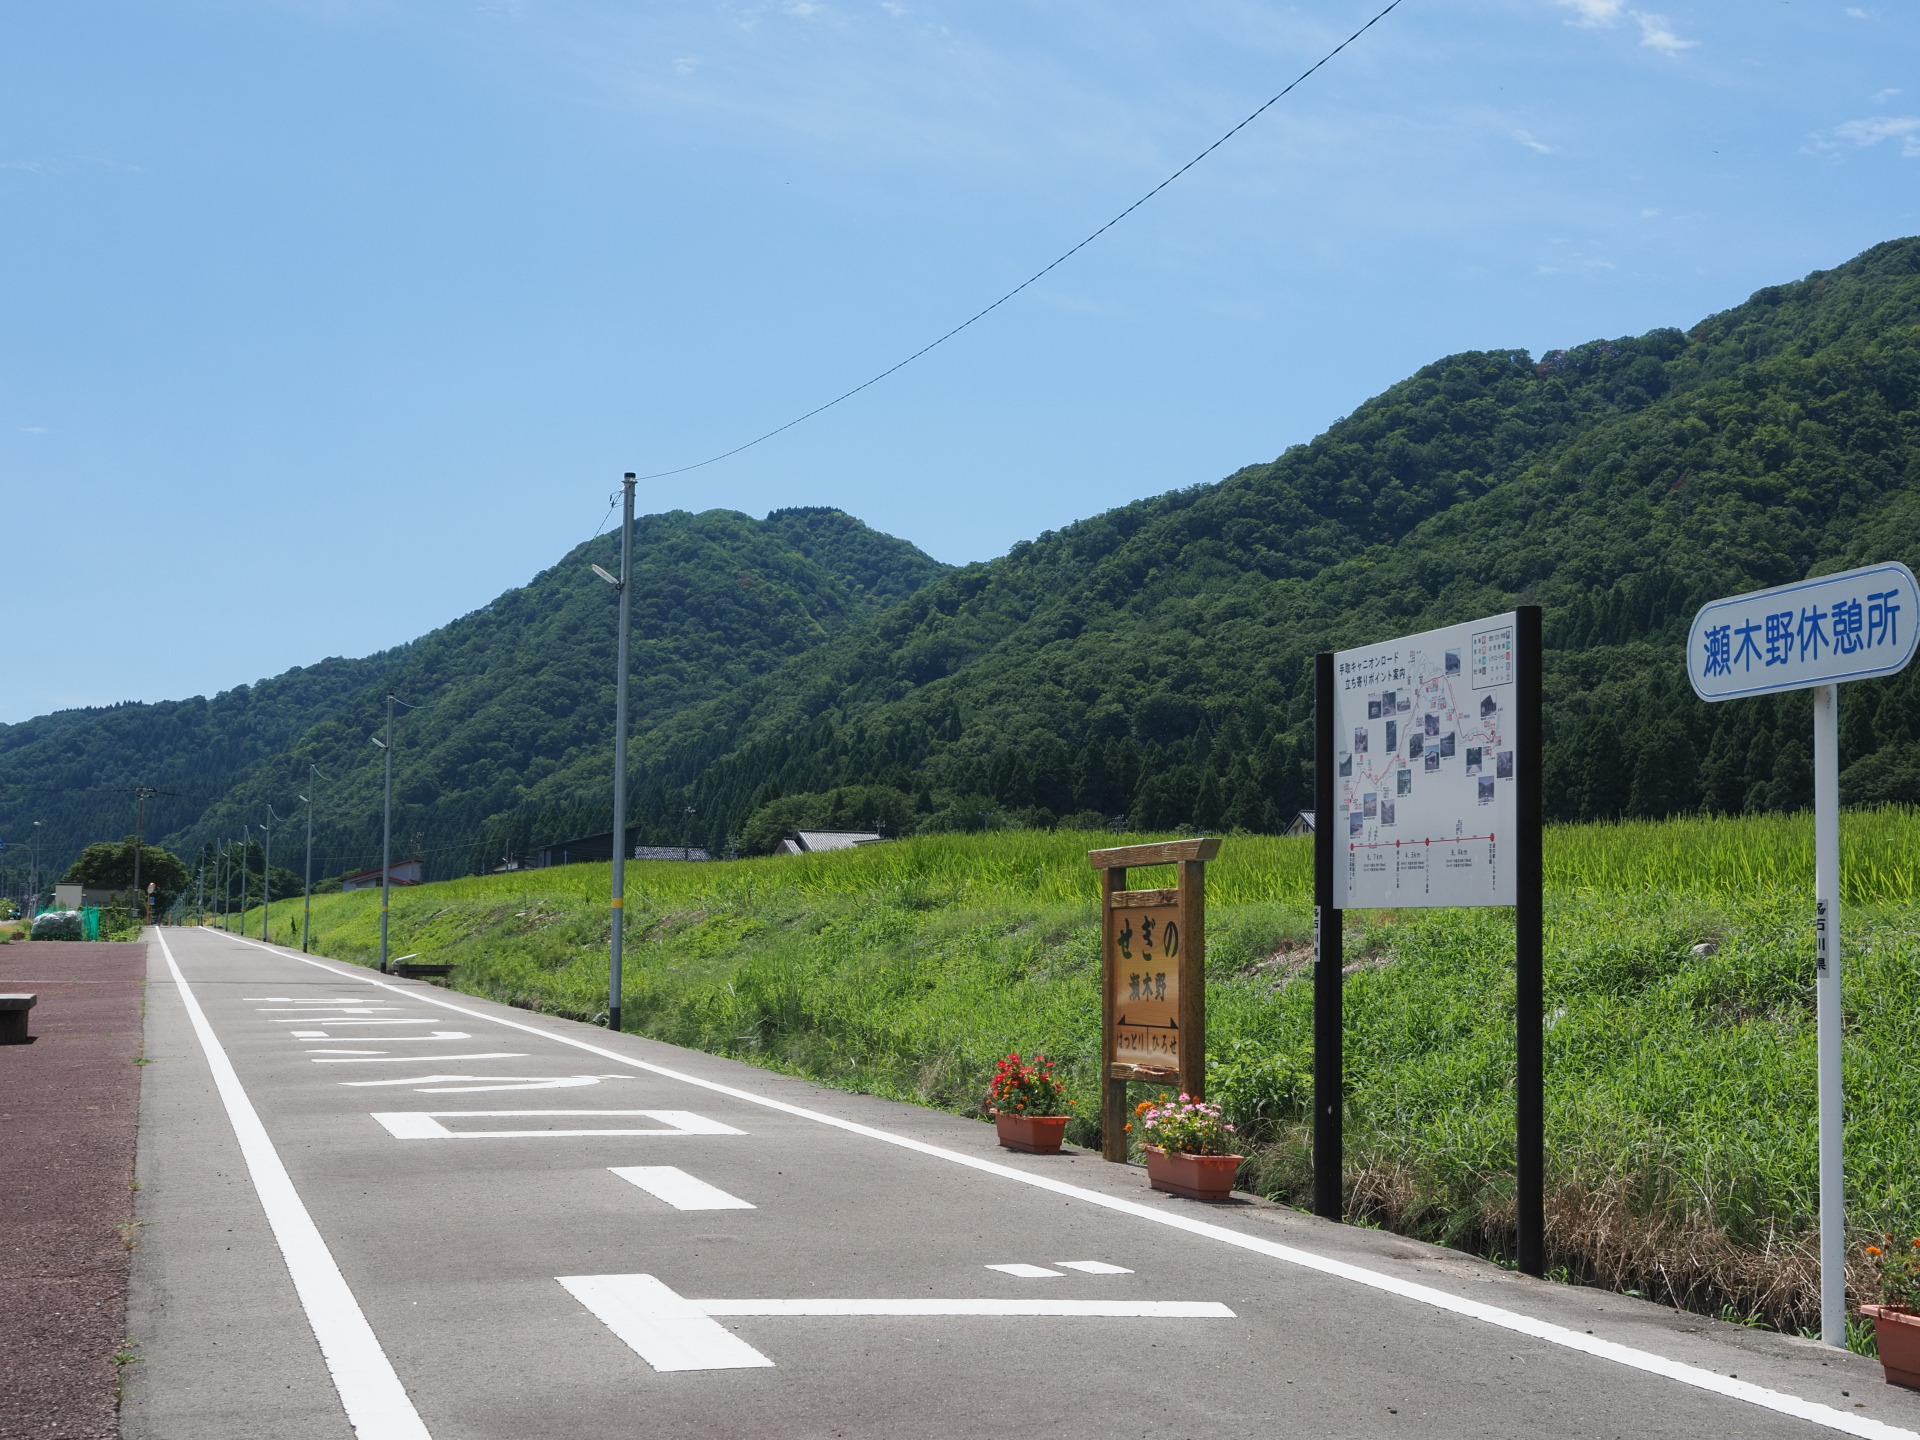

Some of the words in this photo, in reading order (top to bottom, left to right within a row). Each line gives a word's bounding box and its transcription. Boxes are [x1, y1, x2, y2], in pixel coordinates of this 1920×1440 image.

[1703, 588, 1901, 678] 瀬木野休憩所
[1339, 652, 1399, 675] 手取キャニオンロード
[1345, 667, 1406, 690] 立ち寄りポイント案内
[1117, 915, 1179, 962] せぎの
[1129, 972, 1167, 1002] 瀬木野
[1151, 1033, 1178, 1055] ひろせ
